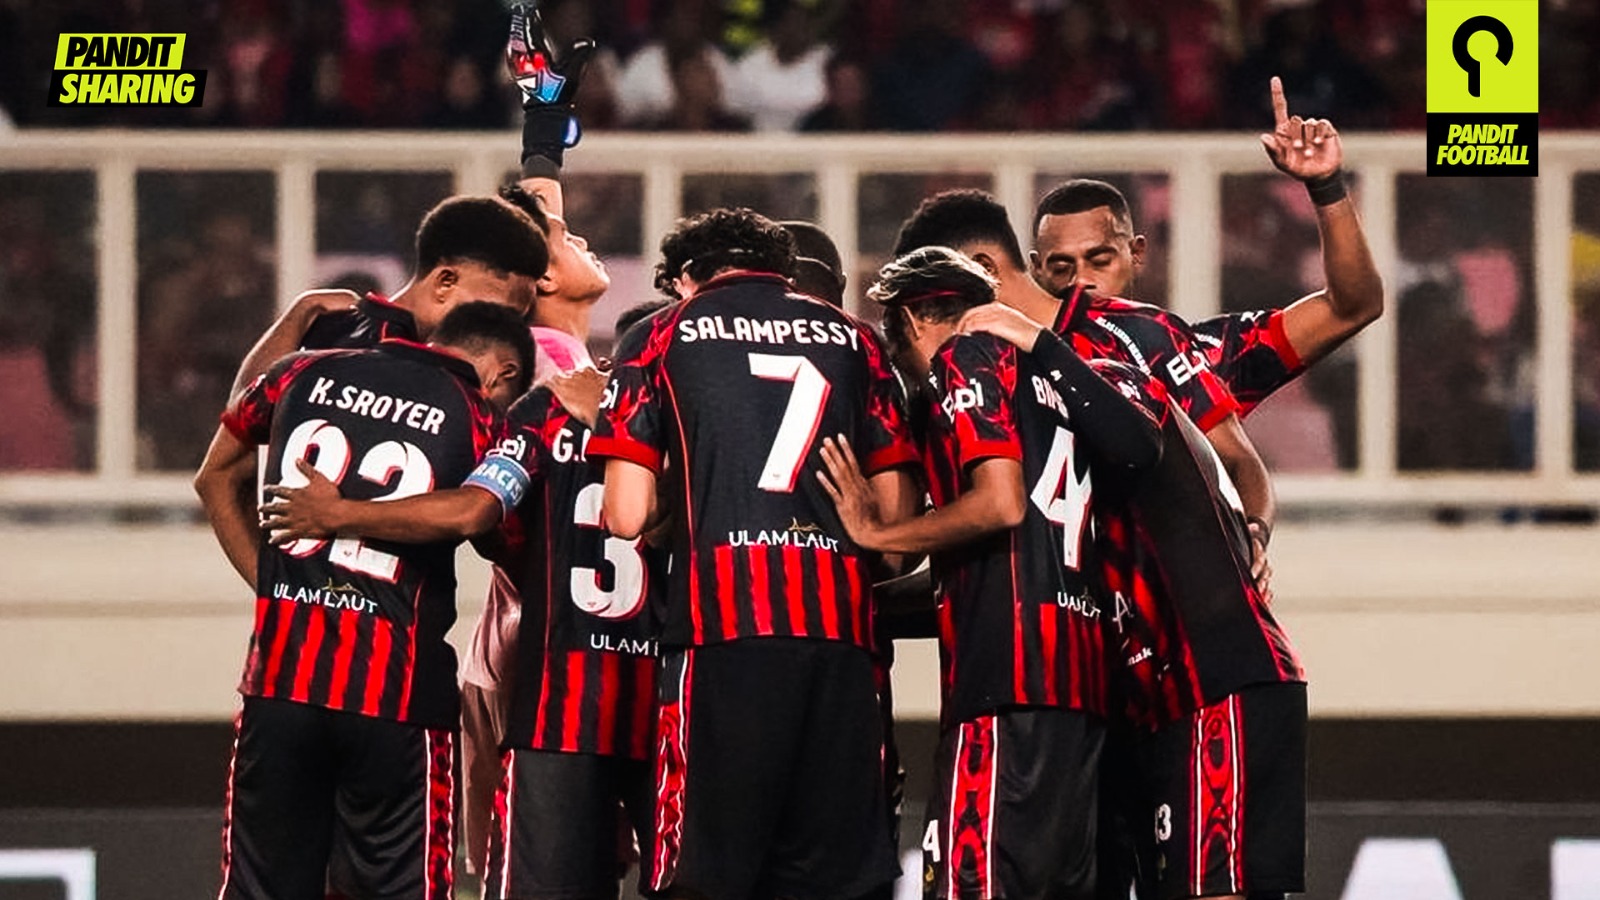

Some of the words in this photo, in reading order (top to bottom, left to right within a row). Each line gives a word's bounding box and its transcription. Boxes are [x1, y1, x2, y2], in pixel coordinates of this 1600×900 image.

[678, 315, 858, 351] SALAMPESSY
[308, 377, 446, 435] K.SROYER
[748, 353, 832, 493] 7
[1030, 426, 1092, 572] 4
[729, 530, 788, 546] ULAM
[793, 532, 838, 552] LAUT
[274, 583, 320, 604] ULAM
[324, 592, 378, 613] LAUT
[591, 633, 649, 656] ULAM
[922, 819, 941, 862] 4
